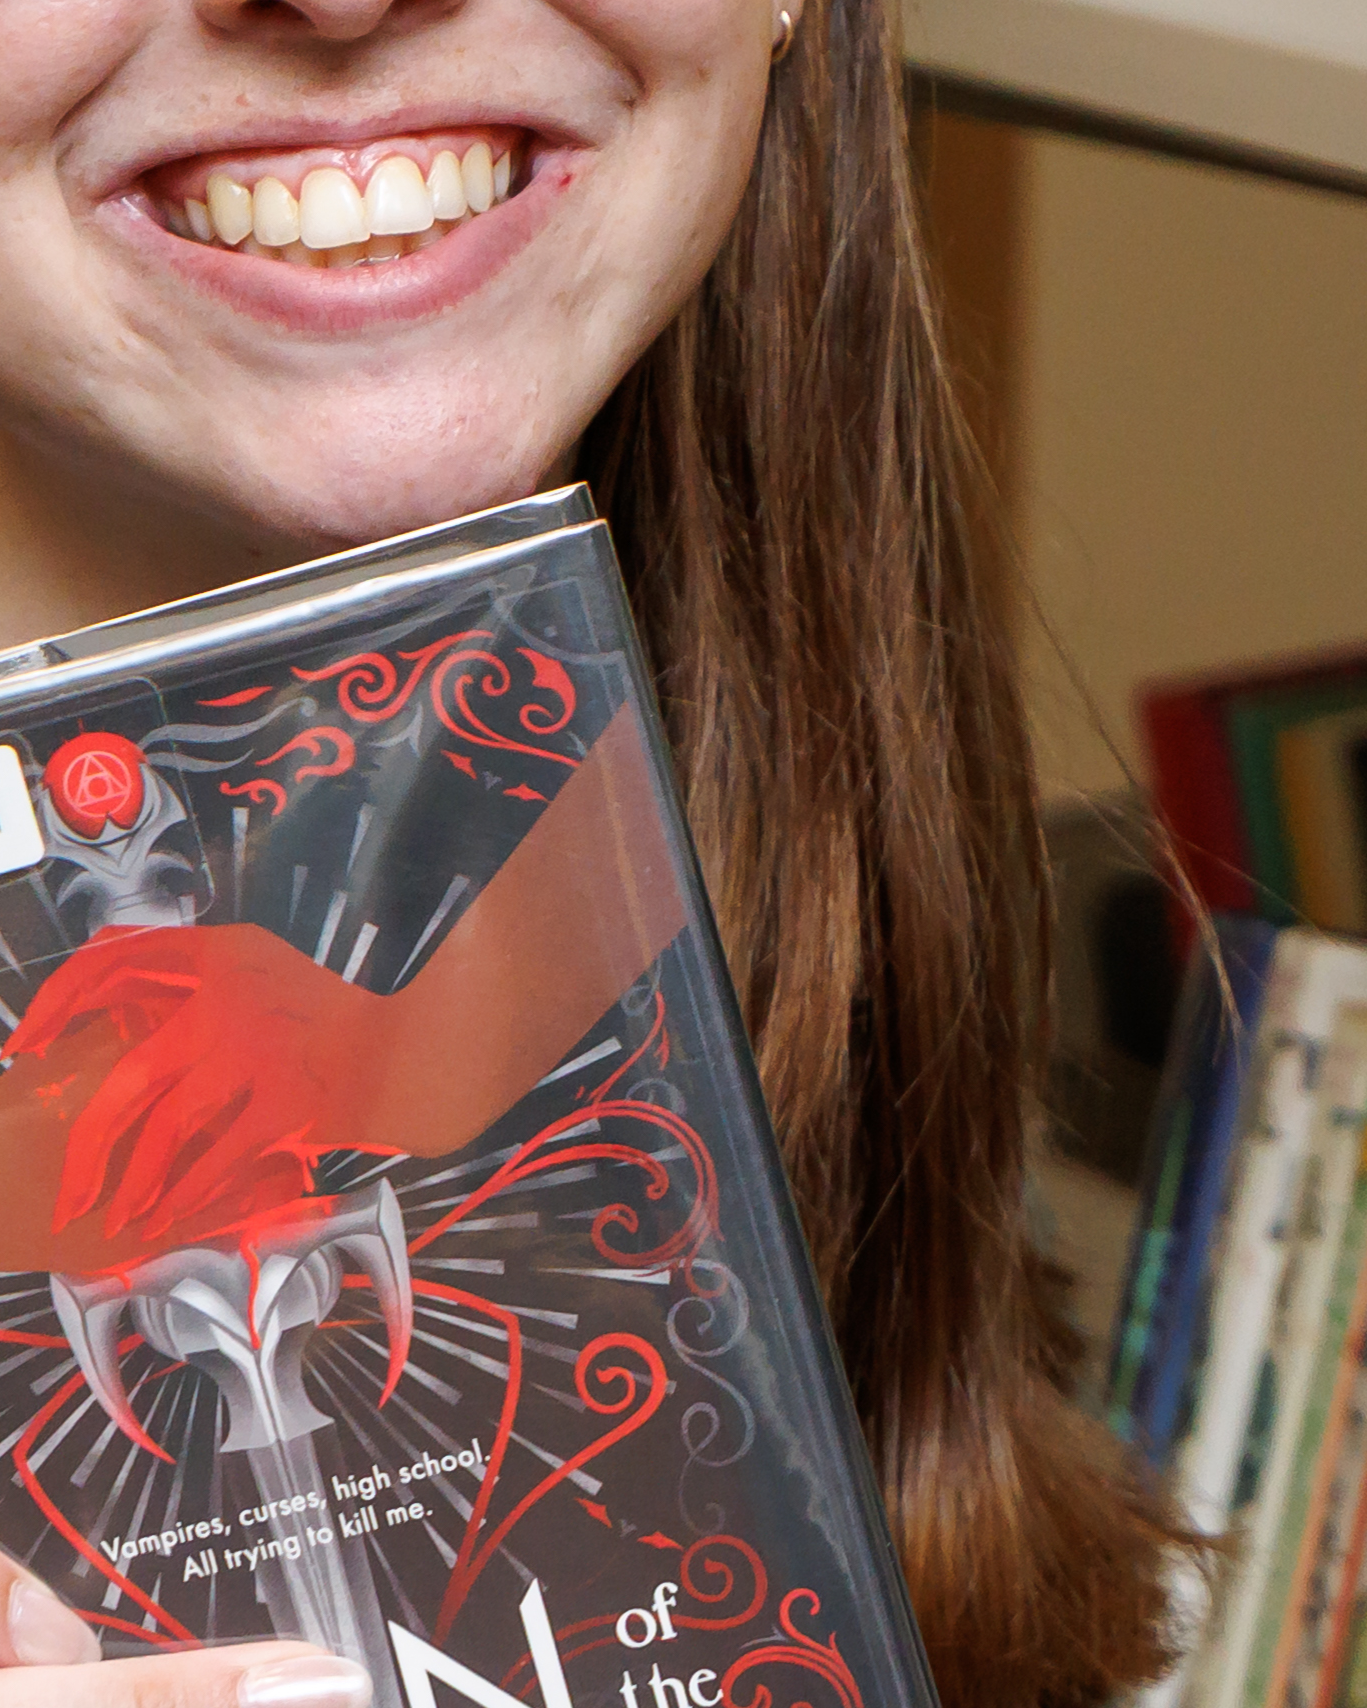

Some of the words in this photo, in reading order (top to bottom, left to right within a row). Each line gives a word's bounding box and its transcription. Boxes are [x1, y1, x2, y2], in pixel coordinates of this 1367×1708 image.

[100, 1517, 231, 1563] Vampires,
[238, 1490, 328, 1528] curses,
[331, 1465, 392, 1502] high
[398, 1437, 493, 1485] school.
[182, 1549, 219, 1583] All
[224, 1535, 302, 1573] trying
[306, 1526, 334, 1547] to
[338, 1504, 380, 1540] kill
[385, 1499, 434, 1525] me.
[615, 1581, 680, 1649] of
